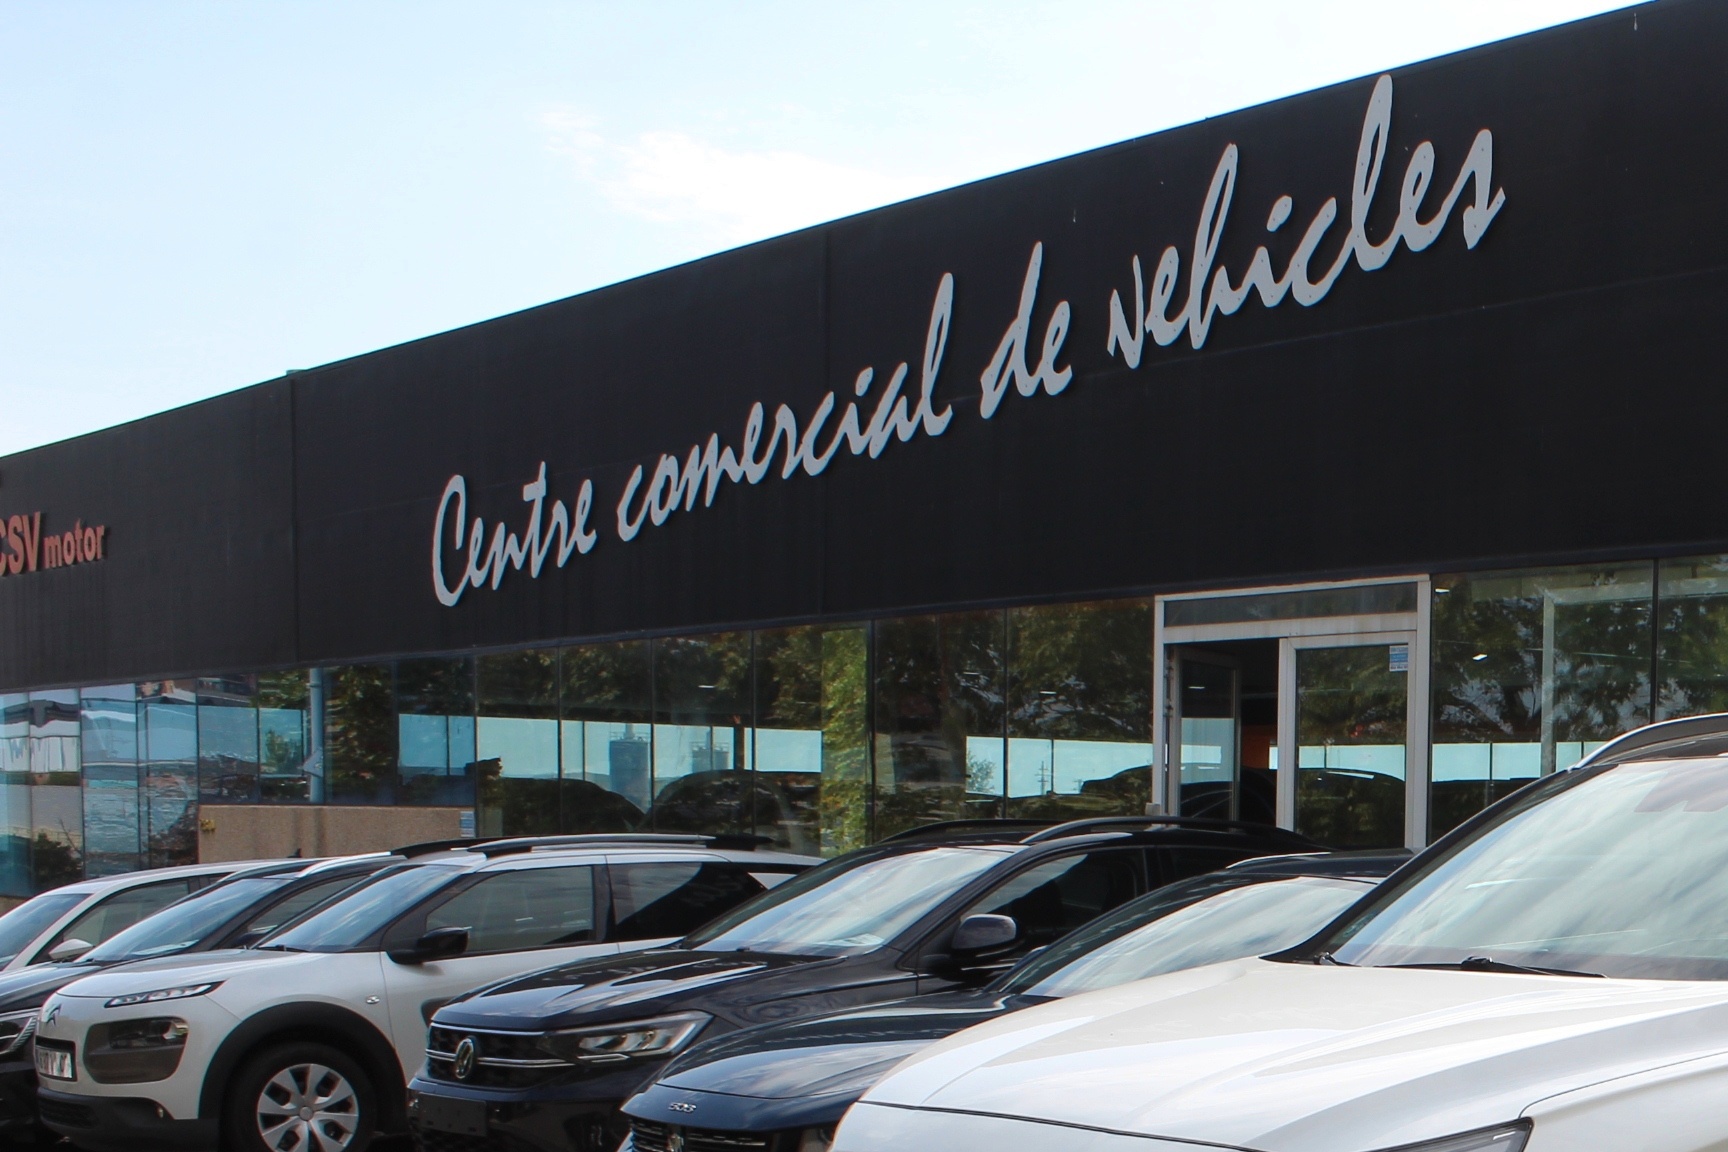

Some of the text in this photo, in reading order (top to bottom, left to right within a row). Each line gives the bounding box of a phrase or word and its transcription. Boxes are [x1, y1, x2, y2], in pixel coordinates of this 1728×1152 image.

[432, 73, 1506, 607] Centre comercial de vehicles
[44, 517, 105, 569] motor
